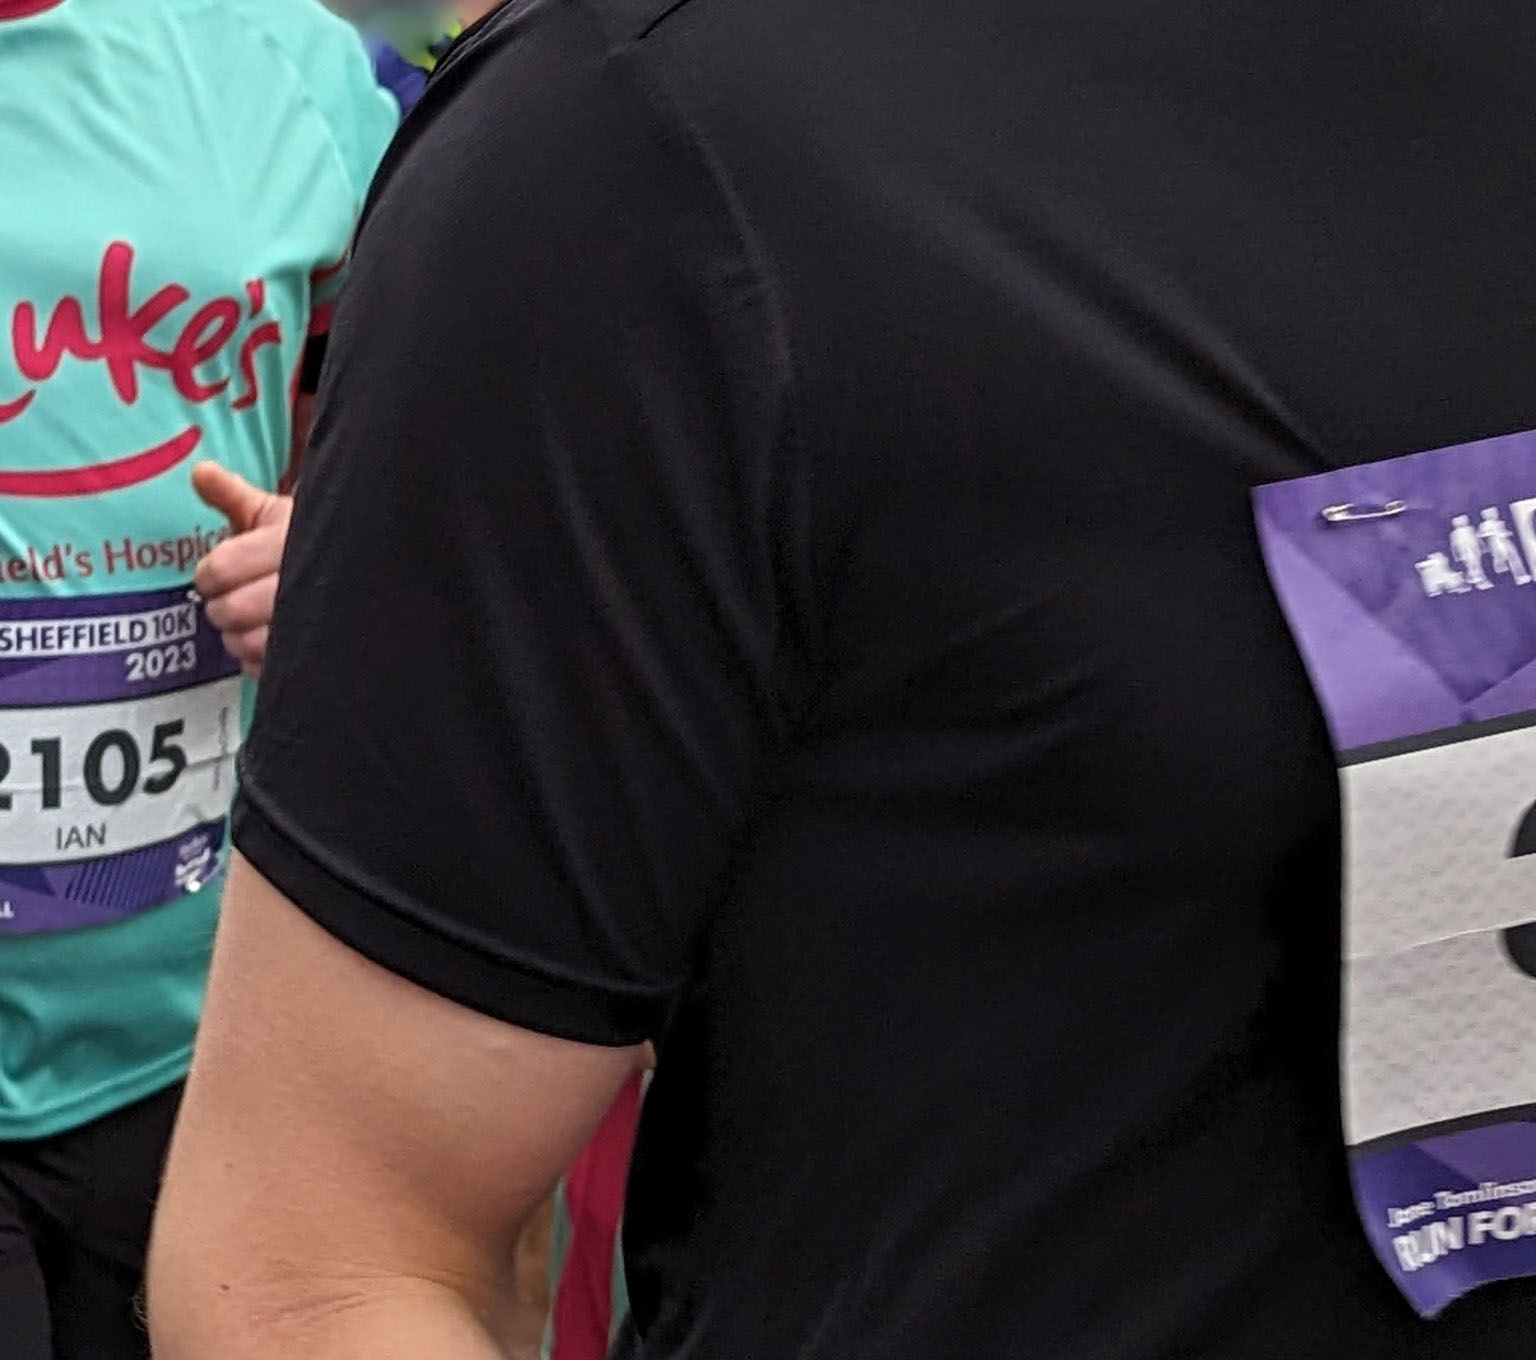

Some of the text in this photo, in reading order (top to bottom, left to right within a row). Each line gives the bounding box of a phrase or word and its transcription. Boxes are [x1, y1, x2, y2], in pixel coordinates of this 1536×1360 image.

[153, 607, 192, 638] 10K
[126, 641, 196, 682] 2023
[56, 824, 107, 850] IAN
